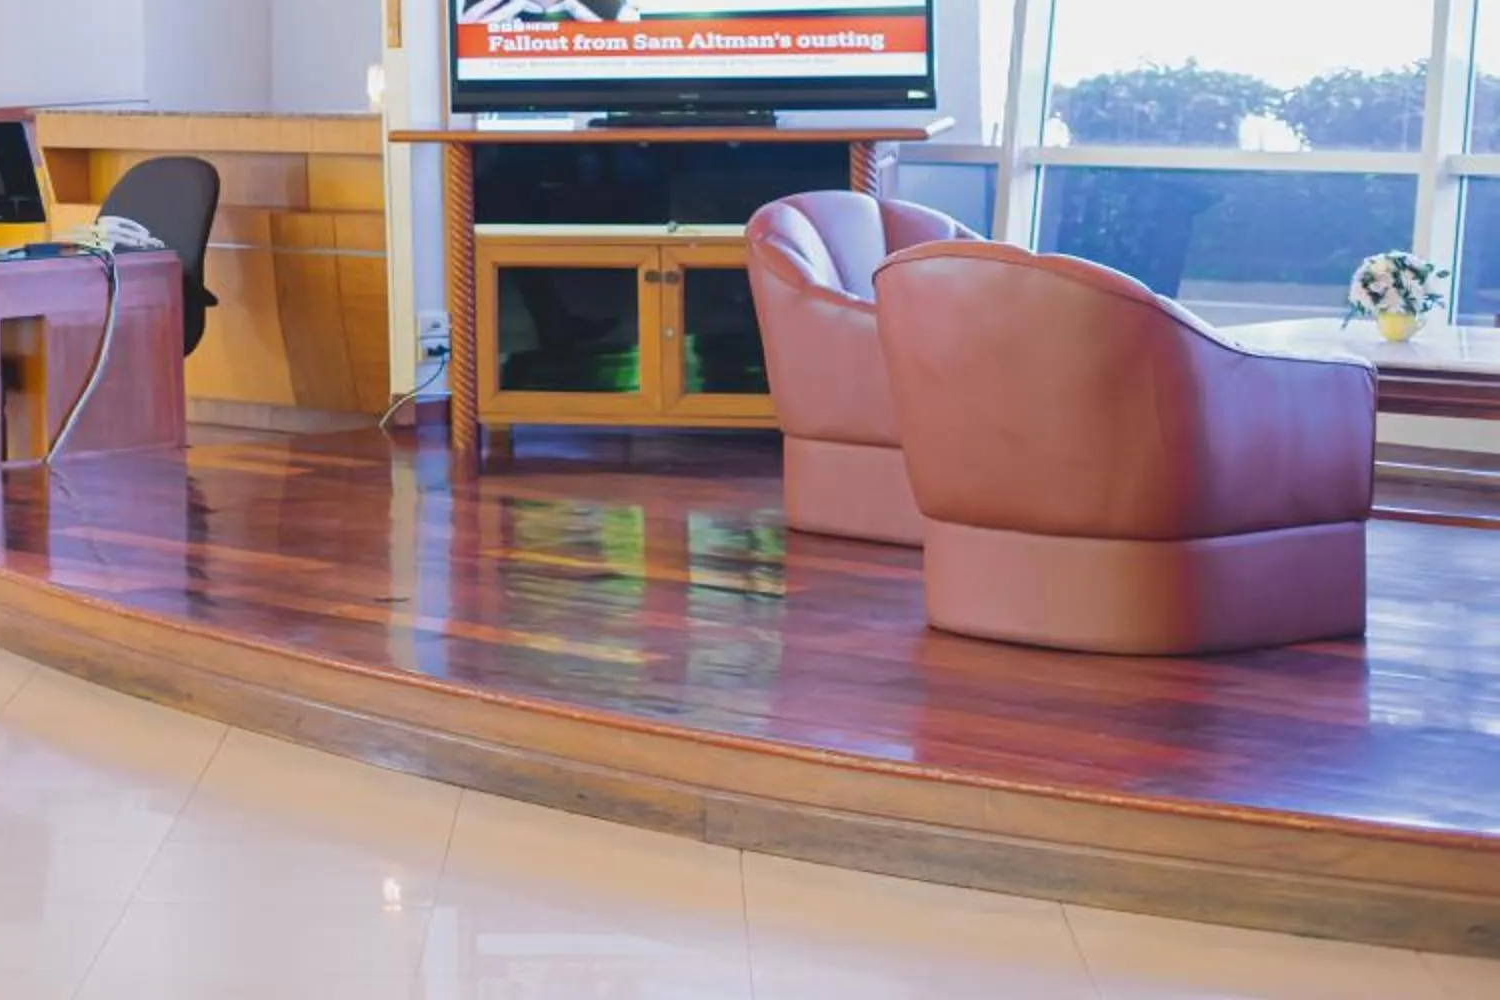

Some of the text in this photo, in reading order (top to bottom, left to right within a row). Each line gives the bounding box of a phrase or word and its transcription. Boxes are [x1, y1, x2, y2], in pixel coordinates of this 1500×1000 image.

[488, 31, 885, 52] Fallout from Sam Altman's ousting
